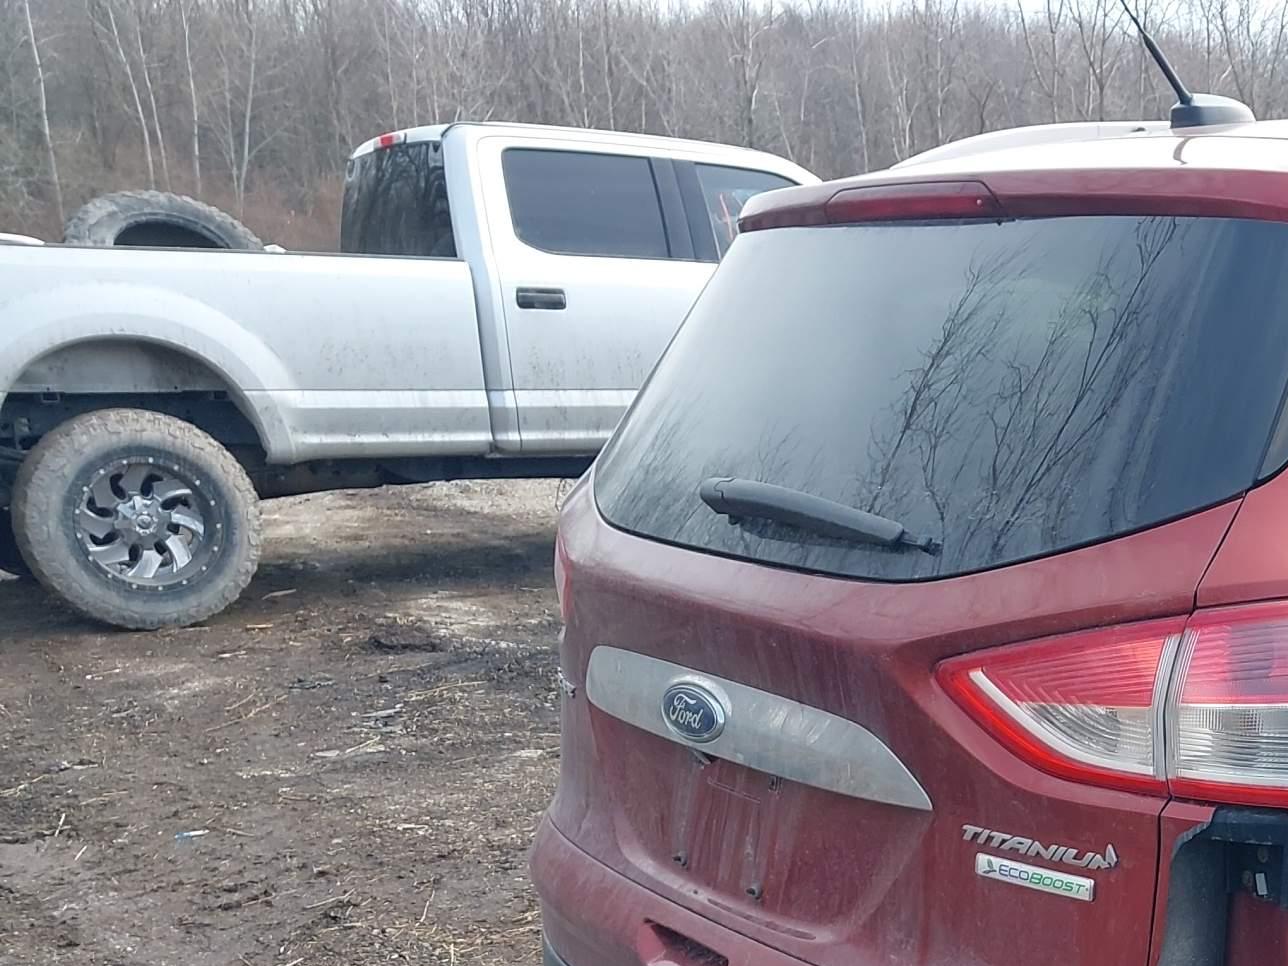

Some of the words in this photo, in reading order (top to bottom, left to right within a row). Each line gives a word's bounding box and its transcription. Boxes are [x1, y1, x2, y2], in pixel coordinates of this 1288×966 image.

[669, 693, 705, 729] Ford
[962, 824, 1118, 869] TITANIUM
[998, 863, 1087, 894] ECOBOOST
